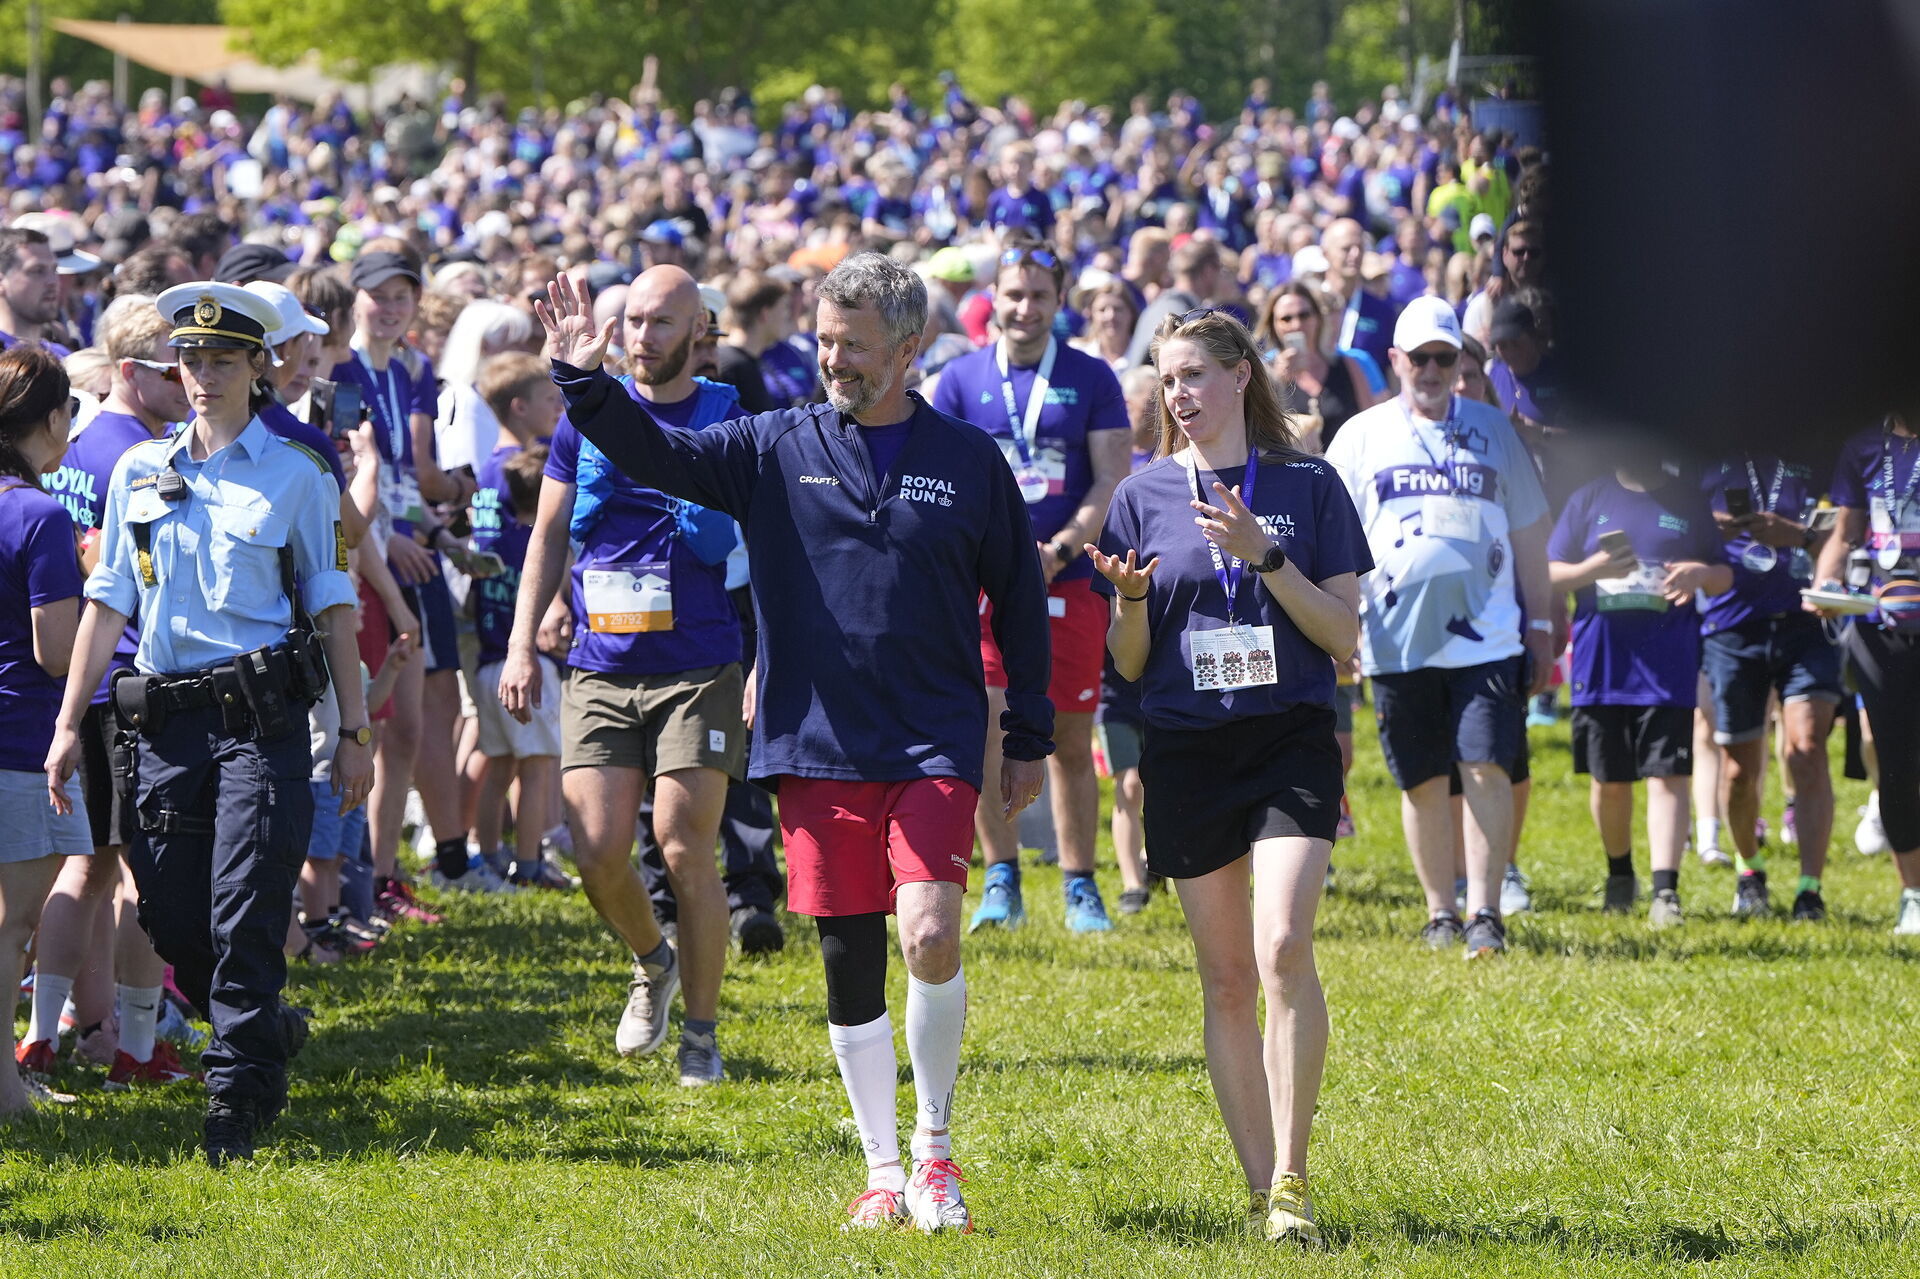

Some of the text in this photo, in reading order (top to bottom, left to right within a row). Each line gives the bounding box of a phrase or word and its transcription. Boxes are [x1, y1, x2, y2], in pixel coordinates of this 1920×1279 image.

[799, 475, 832, 486] CRAFT
[1883, 456, 1894, 488] ROYAL
[901, 475, 956, 495] ROYAL
[1392, 468, 1484, 495] Frivilig
[899, 487, 936, 504] RUN
[1255, 514, 1295, 526] OYAL
[1208, 541, 1224, 572] ROYA
[609, 613, 643, 625] 29792
